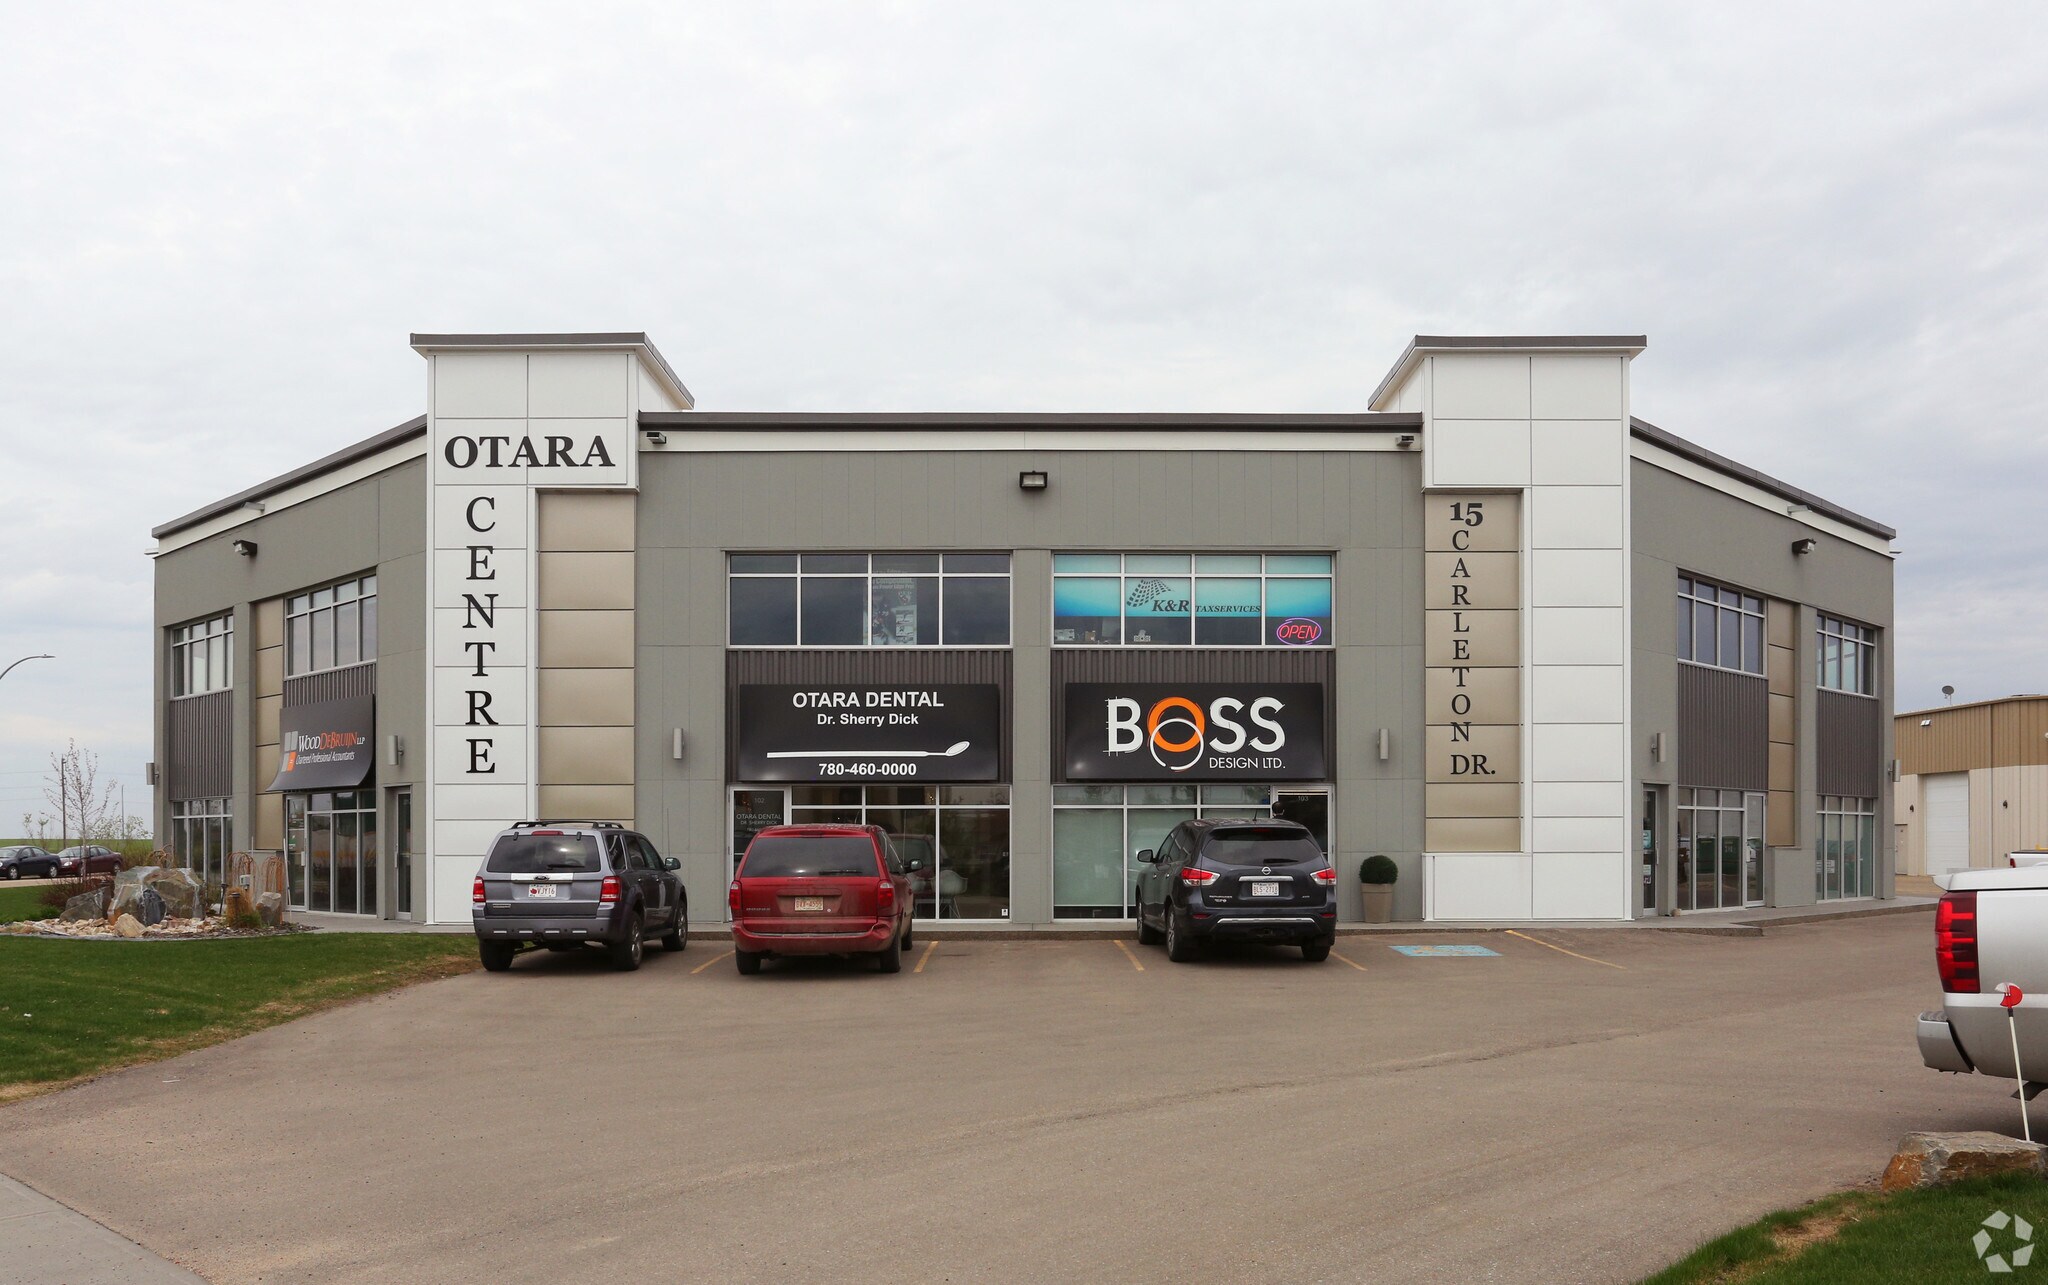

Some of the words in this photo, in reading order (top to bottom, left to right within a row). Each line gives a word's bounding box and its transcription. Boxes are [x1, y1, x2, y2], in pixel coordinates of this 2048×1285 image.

[445, 435, 616, 468] OTARA
[1450, 502, 1484, 527] 15
[1152, 600, 1189, 612] K&R
[462, 496, 499, 774] CENTRE
[1279, 624, 1319, 639] OPEN
[1451, 530, 1471, 742] CARLETON
[792, 691, 860, 708] OTARA
[866, 691, 944, 708] DENTAL
[817, 713, 835, 725] Dr.
[840, 713, 885, 727] Sherry
[889, 713, 919, 725] Dick
[1104, 696, 1286, 757] BOSS
[818, 763, 917, 776] 780-460-0000
[1209, 757, 1259, 769] DESIGN
[1262, 757, 1286, 769] LTD.
[1451, 754, 1496, 775] DR.
